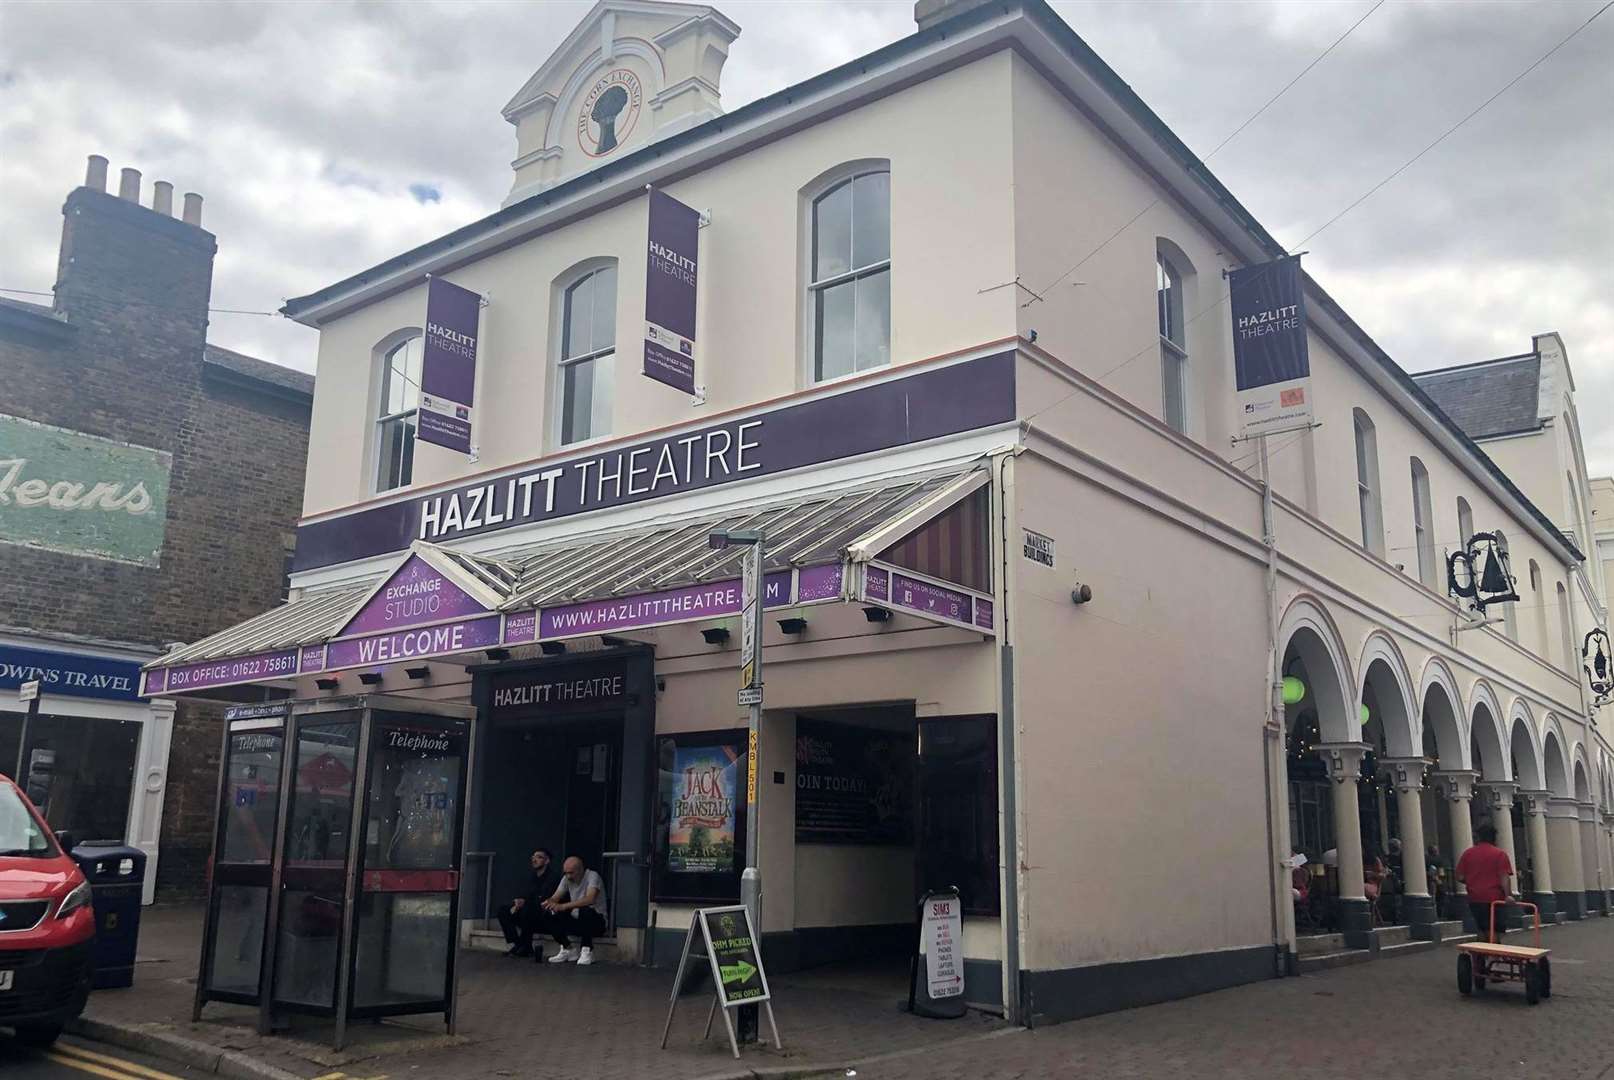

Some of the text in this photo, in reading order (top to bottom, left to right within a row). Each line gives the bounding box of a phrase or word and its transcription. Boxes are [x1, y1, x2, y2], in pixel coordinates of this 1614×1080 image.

[650, 240, 697, 273] HAZLITT
[650, 255, 696, 288] THEATRE
[1239, 305, 1297, 329] HAZLITT
[1240, 317, 1299, 341] THEATRE
[428, 321, 476, 348] HAZLITT
[428, 335, 475, 361] THEATRE
[419, 420, 763, 539] HAZLITT THEATRE
[1026, 533, 1050, 553] MARKET
[1023, 544, 1053, 567] BUILDINGS
[411, 567, 418, 578] &
[386, 578, 442, 599] EXCHANGE
[384, 594, 441, 620] STUDIO
[552, 582, 779, 629] WWW.HAZLITTTHEATRE.M
[507, 617, 536, 628] HAZLITT
[507, 625, 535, 637] THEATRE
[302, 651, 324, 660] HAZLITT
[358, 625, 464, 662] WELCOME
[64, 671, 132, 692] TRAVEL
[171, 655, 296, 684] BOX OFFICE: 01622 758611
[494, 676, 622, 707] HAZLITT THEATRE
[239, 735, 275, 752] Telephone
[389, 730, 449, 751] Telephone
[682, 767, 723, 799] JACK
[797, 774, 821, 790] OIN
[673, 798, 733, 818] BEANSTALK
